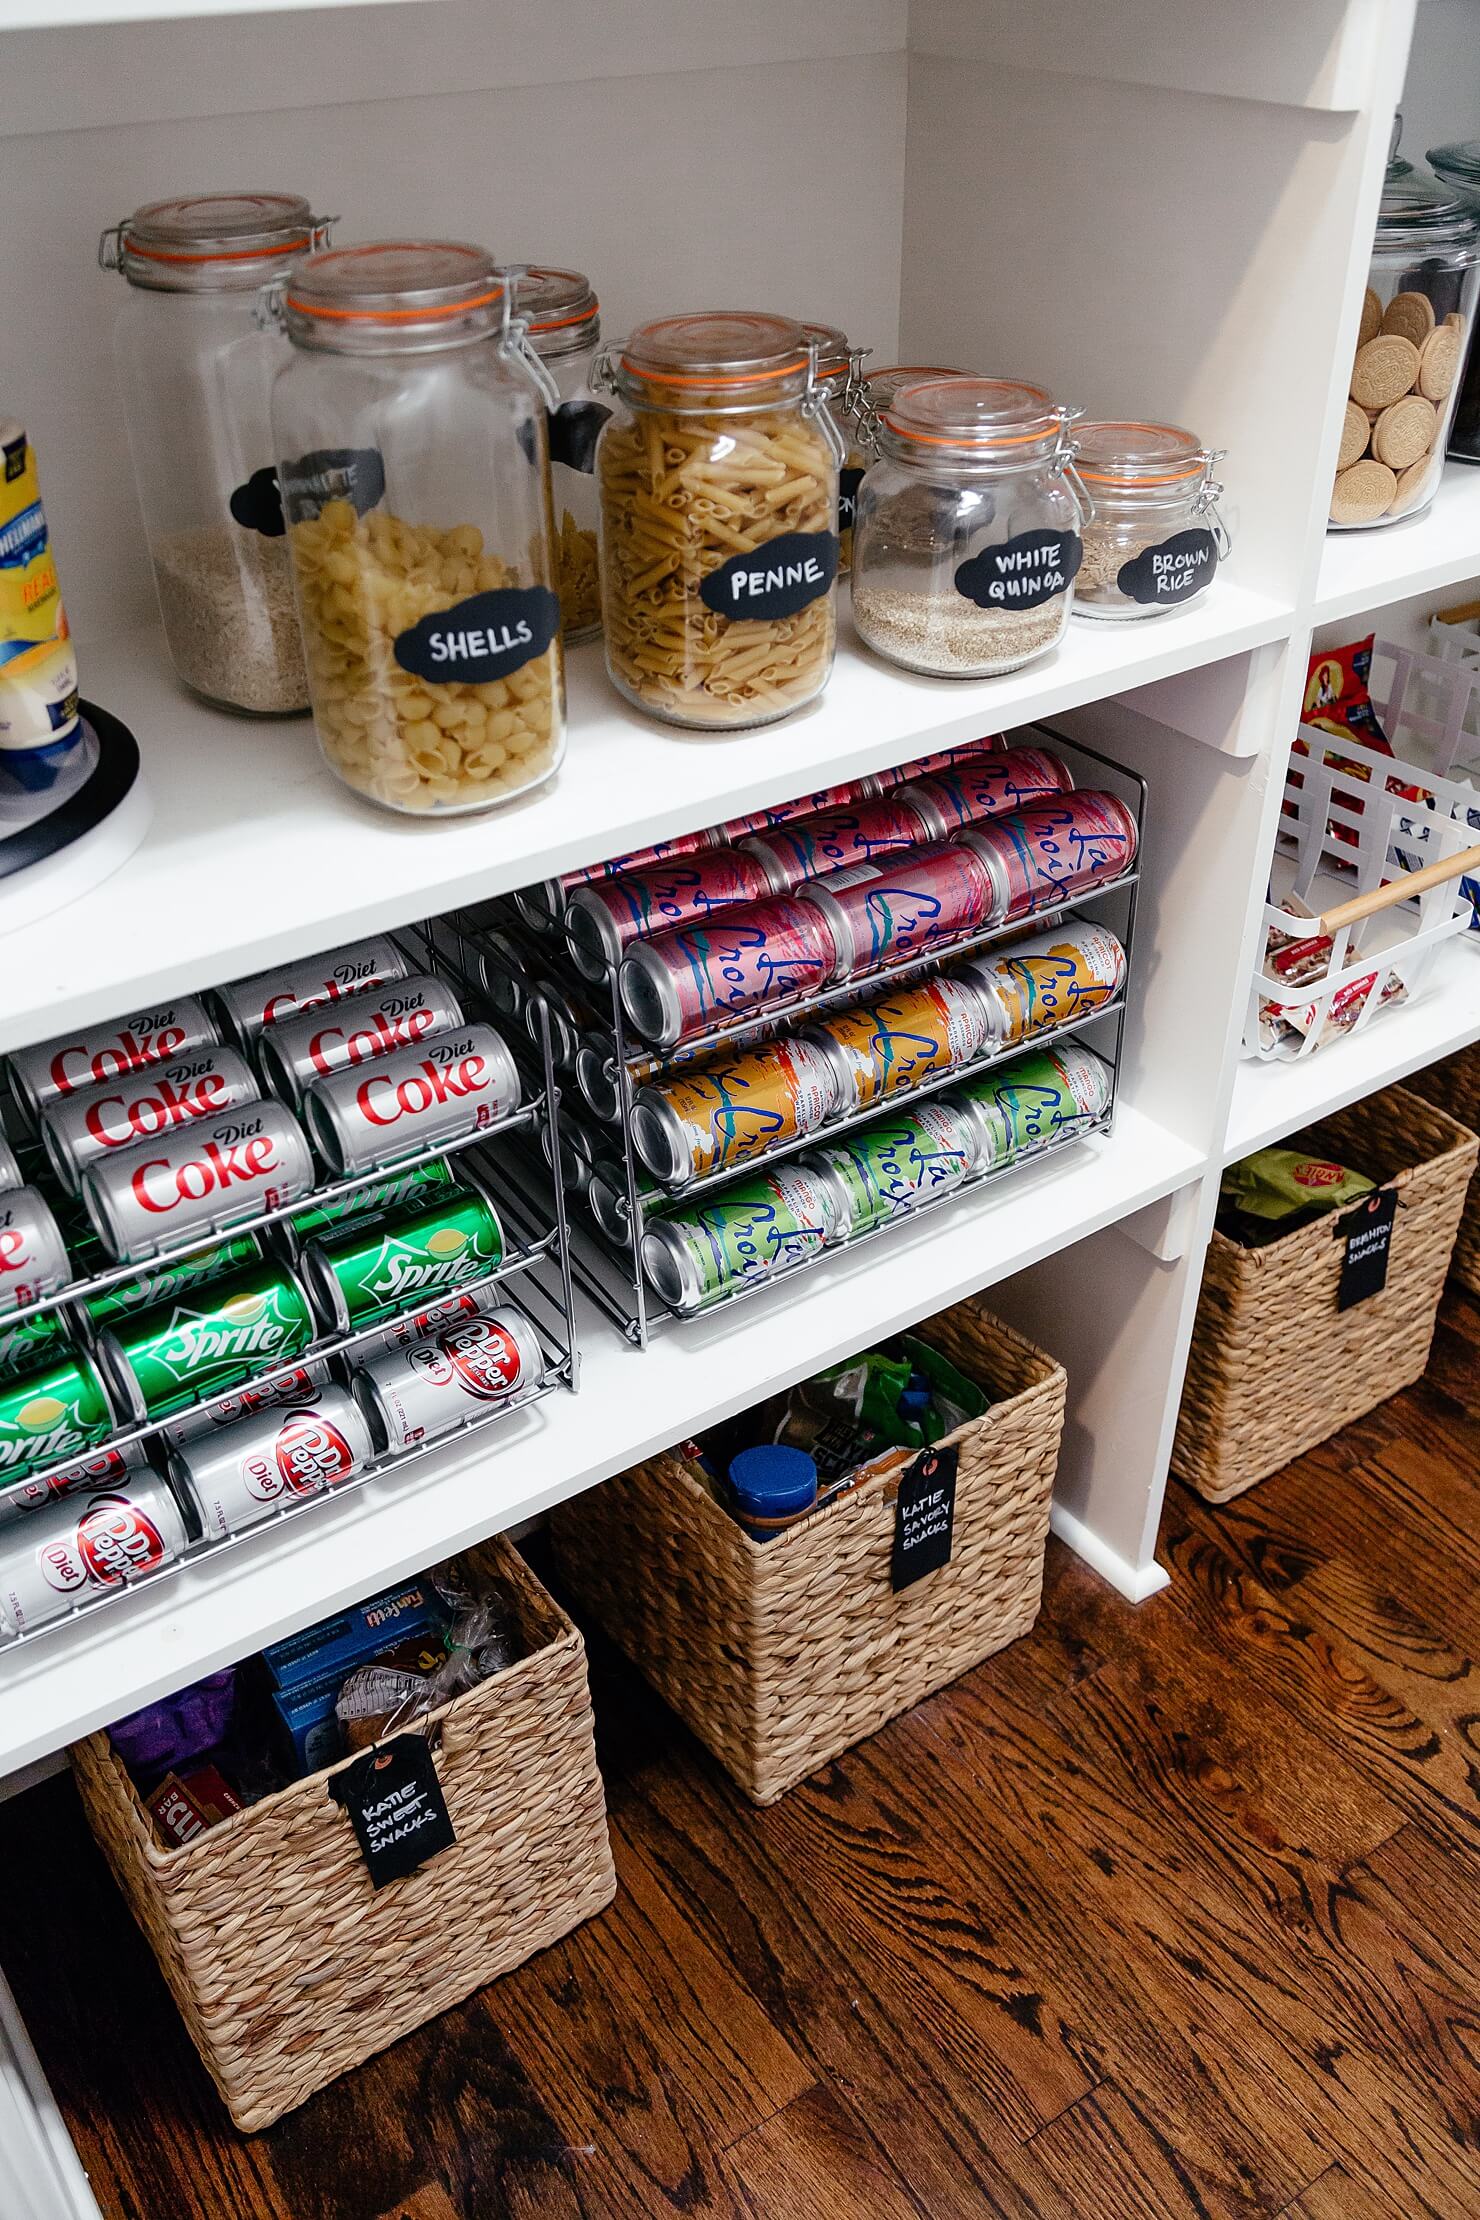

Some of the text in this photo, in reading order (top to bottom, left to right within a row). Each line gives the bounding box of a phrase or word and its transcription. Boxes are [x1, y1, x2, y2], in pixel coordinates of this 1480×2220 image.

[995, 543, 1062, 573] WHITE
[1151, 546, 1210, 575] BROWN
[731, 557, 825, 600] PENNE
[988, 573, 1065, 600] QUINOA
[1156, 568, 1195, 594] RICE
[428, 619, 534, 662] SHELLS
[1000, 808, 1075, 900] Croix
[1068, 827, 1127, 873] La
[679, 925, 767, 1017] Croix
[1092, 935, 1113, 971] APRICOT
[333, 959, 377, 985] Diet
[753, 951, 824, 999] La
[379, 992, 426, 1017] Diet
[128, 1010, 177, 1036] Diet
[959, 1012, 973, 1049] APRICOT
[308, 1008, 436, 1077] Coke
[428, 1039, 476, 1064] Diet
[50, 1026, 187, 1096] Coke
[165, 1058, 215, 1084] Diet
[356, 1054, 491, 1126] Coke
[1078, 1065, 1095, 1097] MANGO
[84, 1074, 230, 1148] Coke
[809, 1085, 820, 1121] APRICOT
[929, 1106, 953, 1134] MANGO
[212, 1117, 264, 1146] Diet
[131, 1135, 280, 1213] Coke
[849, 1129, 917, 1215] Croix
[908, 1147, 966, 1189] La
[793, 1177, 817, 1210] MANGO
[699, 1201, 776, 1288] Croix
[766, 1225, 825, 1265] La
[1348, 1237, 1387, 1265] SNACKS
[372, 1249, 480, 1298] Sprite
[165, 1311, 285, 1369] Sprite
[444, 1318, 509, 1388] Pepper
[475, 1335, 511, 1366] Dr
[413, 1348, 448, 1377] Diet
[248, 1461, 279, 1492] Diet
[319, 1446, 344, 1479] Dr
[902, 1488, 945, 1521] KATIE
[903, 1500, 950, 1536] SAVORY
[126, 1530, 152, 1564] Dr
[903, 1519, 948, 1550] SNACKS
[46, 1549, 81, 1583] Diet
[366, 1591, 425, 1628] Funfetti
[157, 1791, 179, 1815] BAR
[361, 1780, 417, 1822] KATIE
[366, 1791, 428, 1838] SWEET
[166, 1801, 206, 1843] CLI
[370, 1808, 438, 1853] SNACKS
